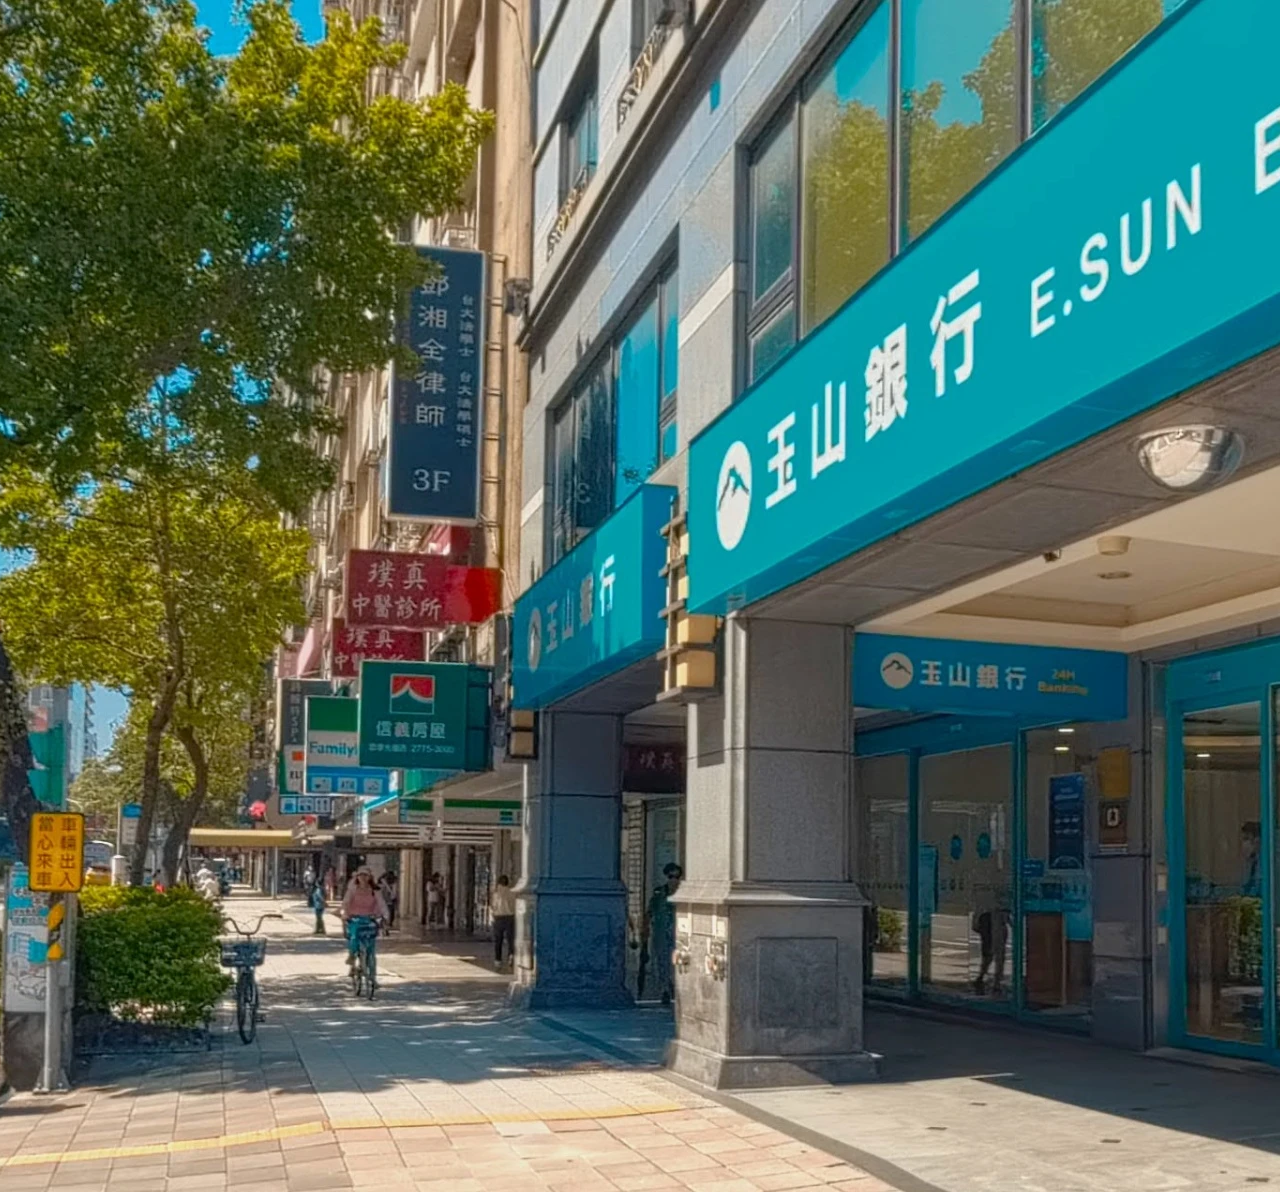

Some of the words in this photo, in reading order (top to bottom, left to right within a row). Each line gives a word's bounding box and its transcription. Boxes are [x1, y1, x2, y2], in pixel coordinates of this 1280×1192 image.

[1030, 162, 1202, 338] E.SUN
[415, 275, 449, 427] 鄧湘全律師
[765, 268, 982, 510] 玉山銀行
[413, 469, 451, 492] 3F
[368, 559, 428, 590] 璞真
[352, 593, 442, 622] 中醫診所
[546, 554, 616, 653] 玉山銀行
[919, 659, 1027, 692] 玉山銀行
[309, 741, 358, 758] Family
[376, 721, 446, 739] 信義房屋
[36, 816, 55, 888] 當心來車
[59, 817, 78, 888] 車輛出入
